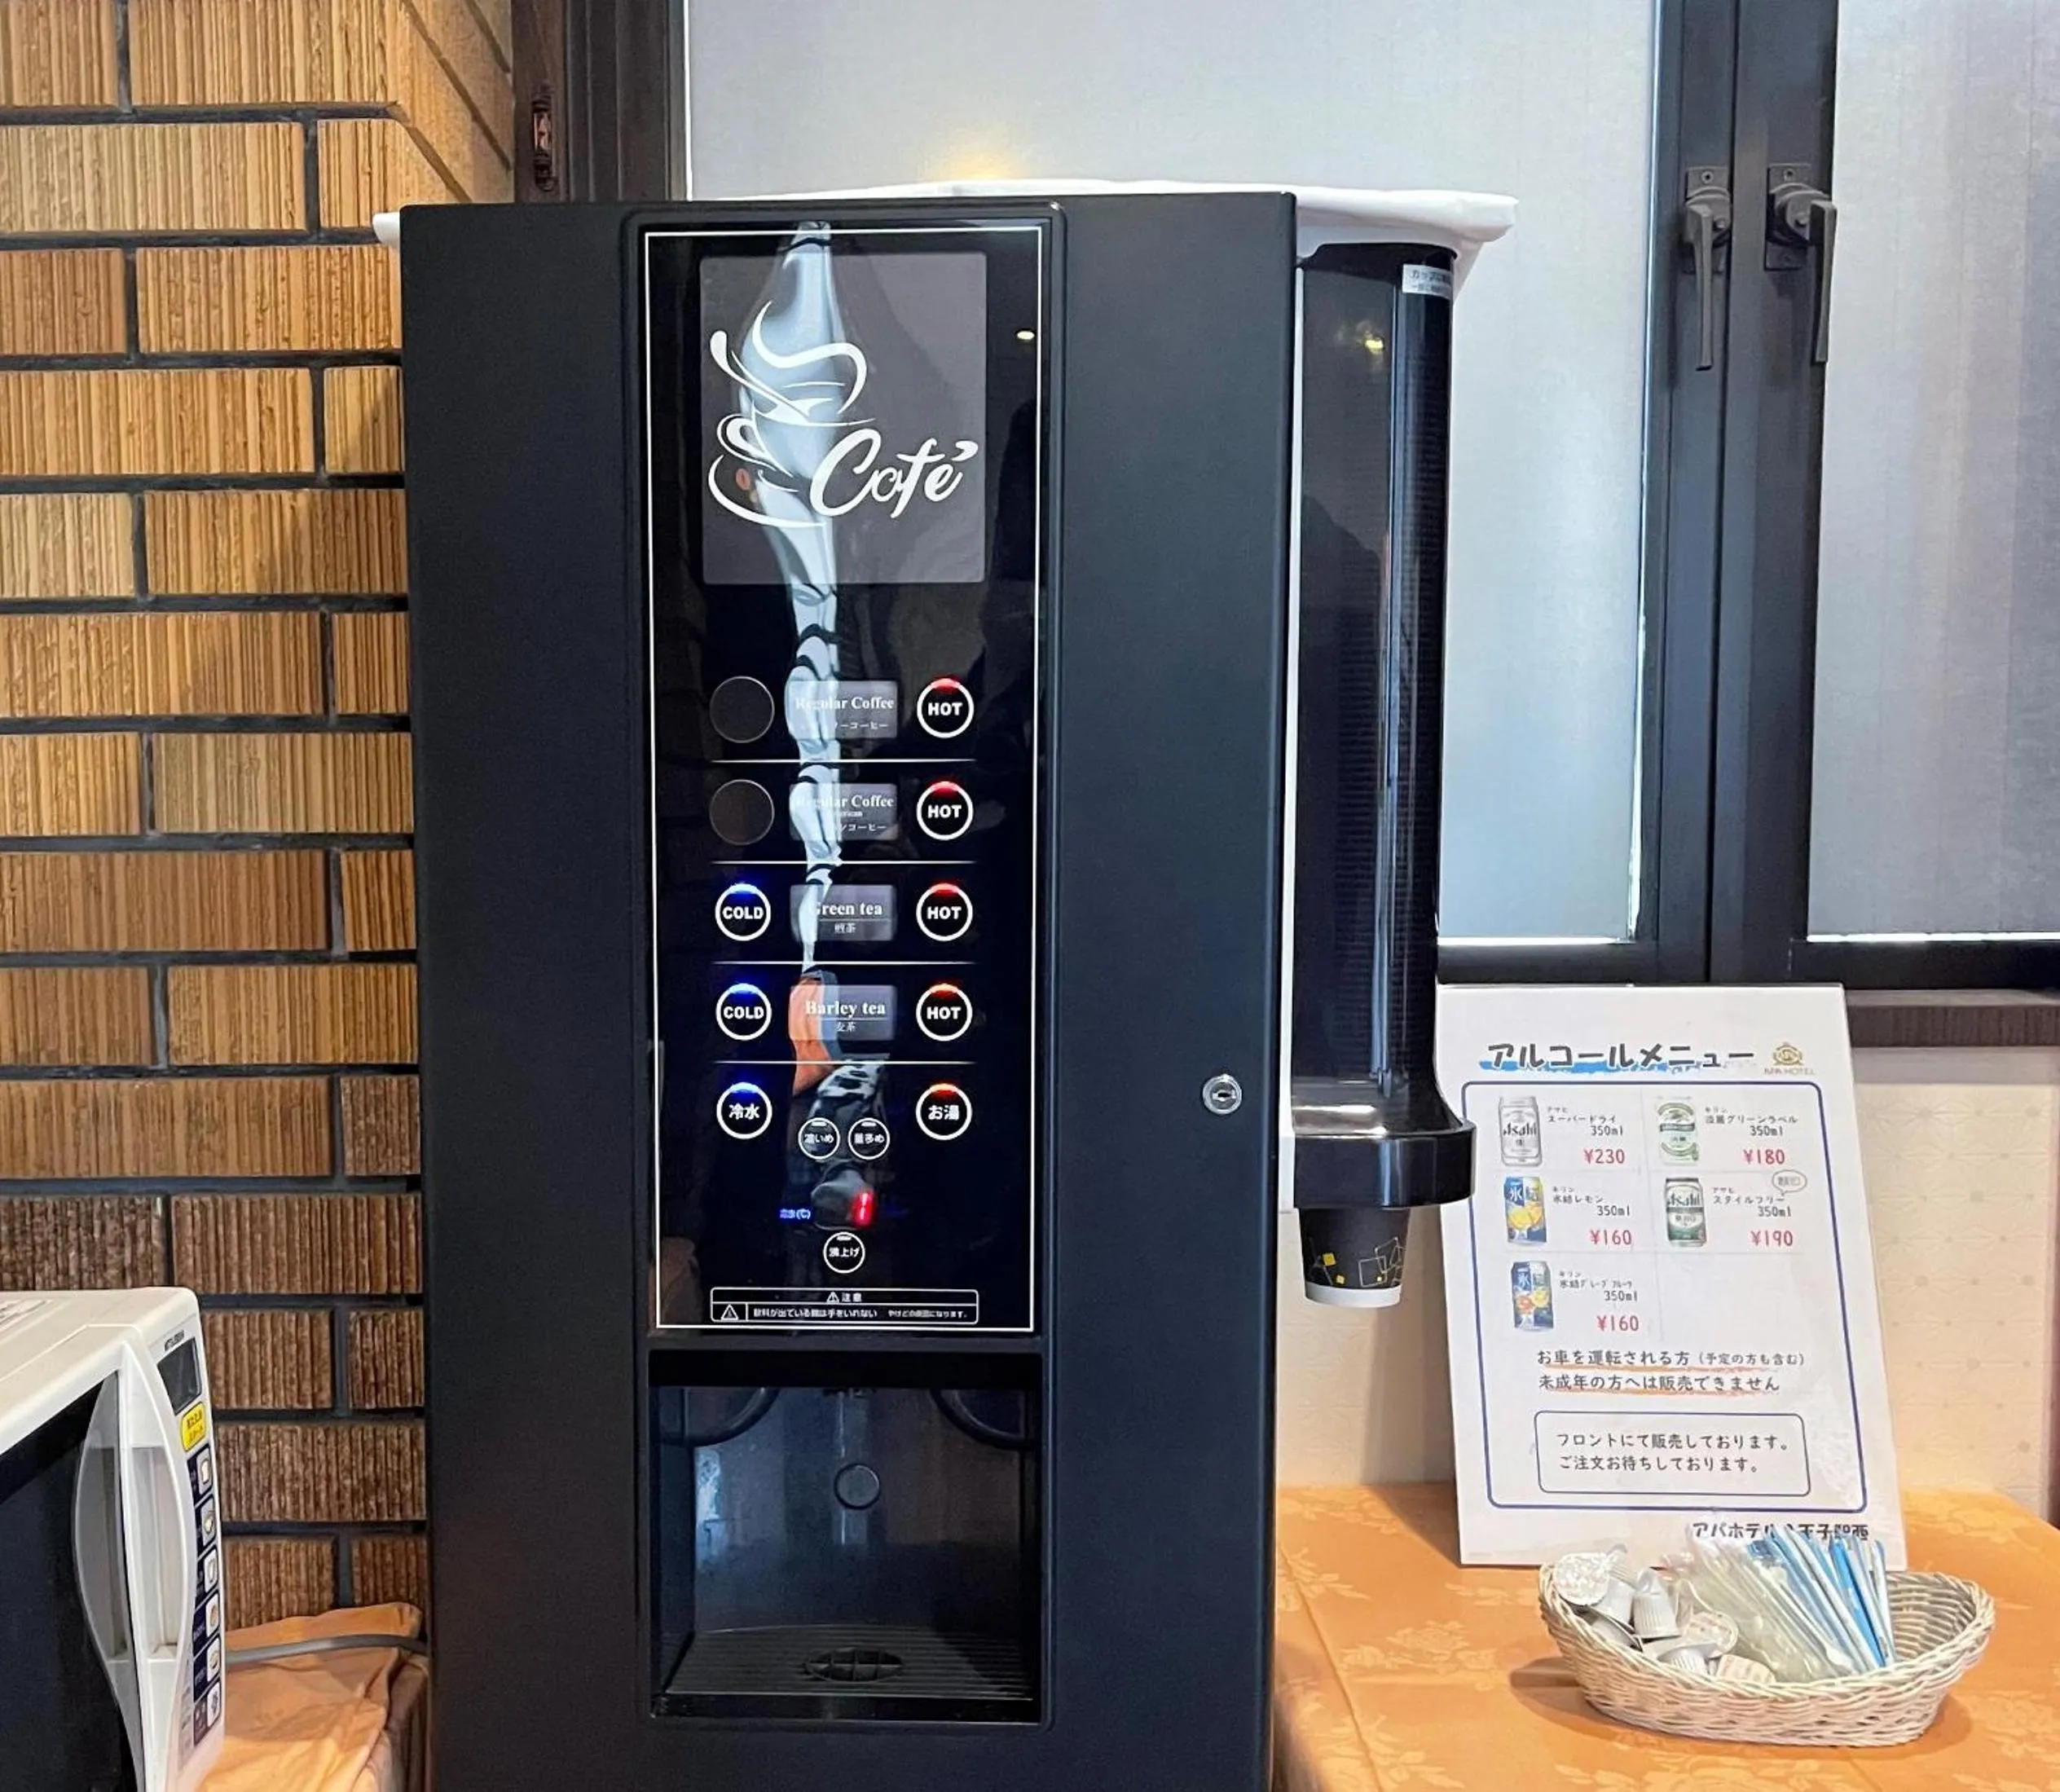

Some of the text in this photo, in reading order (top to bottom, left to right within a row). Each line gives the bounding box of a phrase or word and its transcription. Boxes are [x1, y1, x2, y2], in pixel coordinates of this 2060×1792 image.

[852, 696, 894, 710] Coffee
[927, 702, 962, 716] HOT
[852, 795, 894, 808] Coffee
[927, 804, 962, 818] HOT
[722, 906, 764, 920] COLD
[860, 902, 883, 915] tea
[927, 906, 962, 920] HOT
[723, 1006, 764, 1019] COLD
[805, 1001, 886, 1019] Barley tea
[927, 1006, 962, 1020] HOT
[1488, 1043, 1754, 1069] アルコールメニュー
[728, 1103, 760, 1121] 冷水
[928, 1105, 960, 1121] お湯
[1591, 1125, 1623, 1136] 350ml
[1750, 1125, 1783, 1136] 350ml
[1584, 1148, 1626, 1164] ¥230
[1743, 1149, 1785, 1165] ¥180
[1597, 1205, 1631, 1217] 350ml
[1758, 1206, 1792, 1217] 350ml
[1591, 1230, 1632, 1245] ¥160
[1751, 1231, 1794, 1247] ¥190
[1604, 1290, 1638, 1301] 350ml
[1597, 1315, 1640, 1332] ¥160
[1537, 1350, 1689, 1366] お車を運転される方
[1538, 1375, 1780, 1392] 未成年の方へは販売できません
[1556, 1433, 1789, 1451] フロントにて販売しております。
[1559, 1455, 1757, 1473] ご注文お待ちしております。
